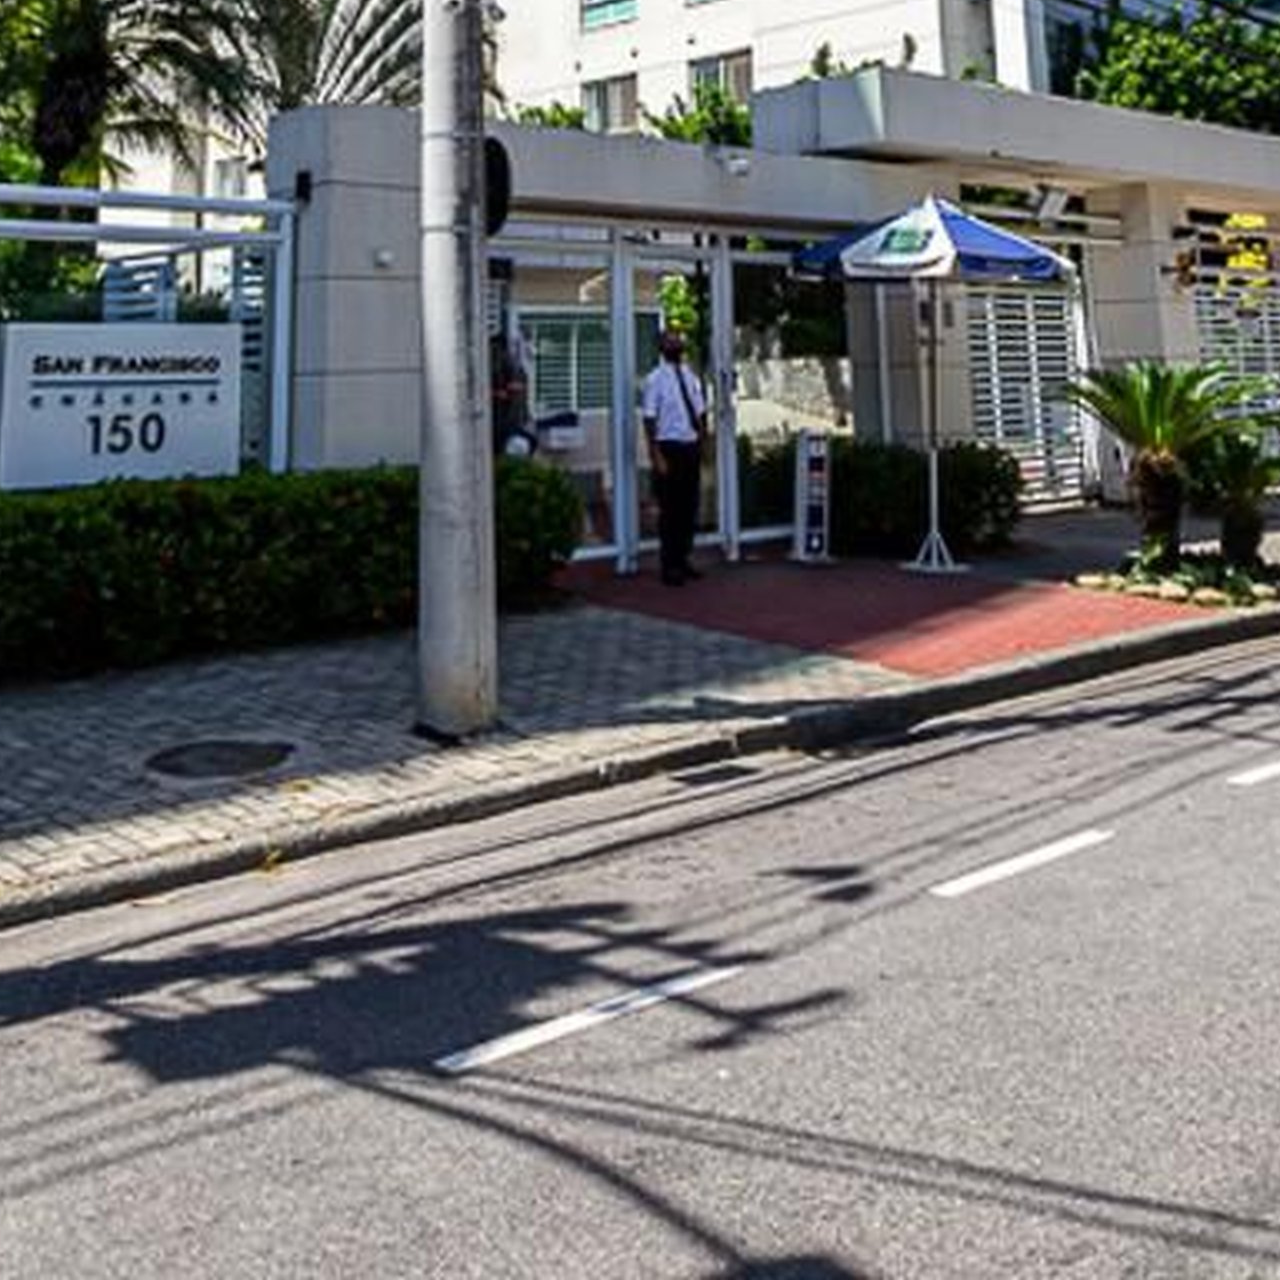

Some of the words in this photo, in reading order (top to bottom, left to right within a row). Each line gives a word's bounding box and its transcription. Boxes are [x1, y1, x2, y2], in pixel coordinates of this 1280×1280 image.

[32, 355, 84, 375] SAN
[91, 354, 220, 375] FRANCISCO
[86, 412, 166, 455] 150
